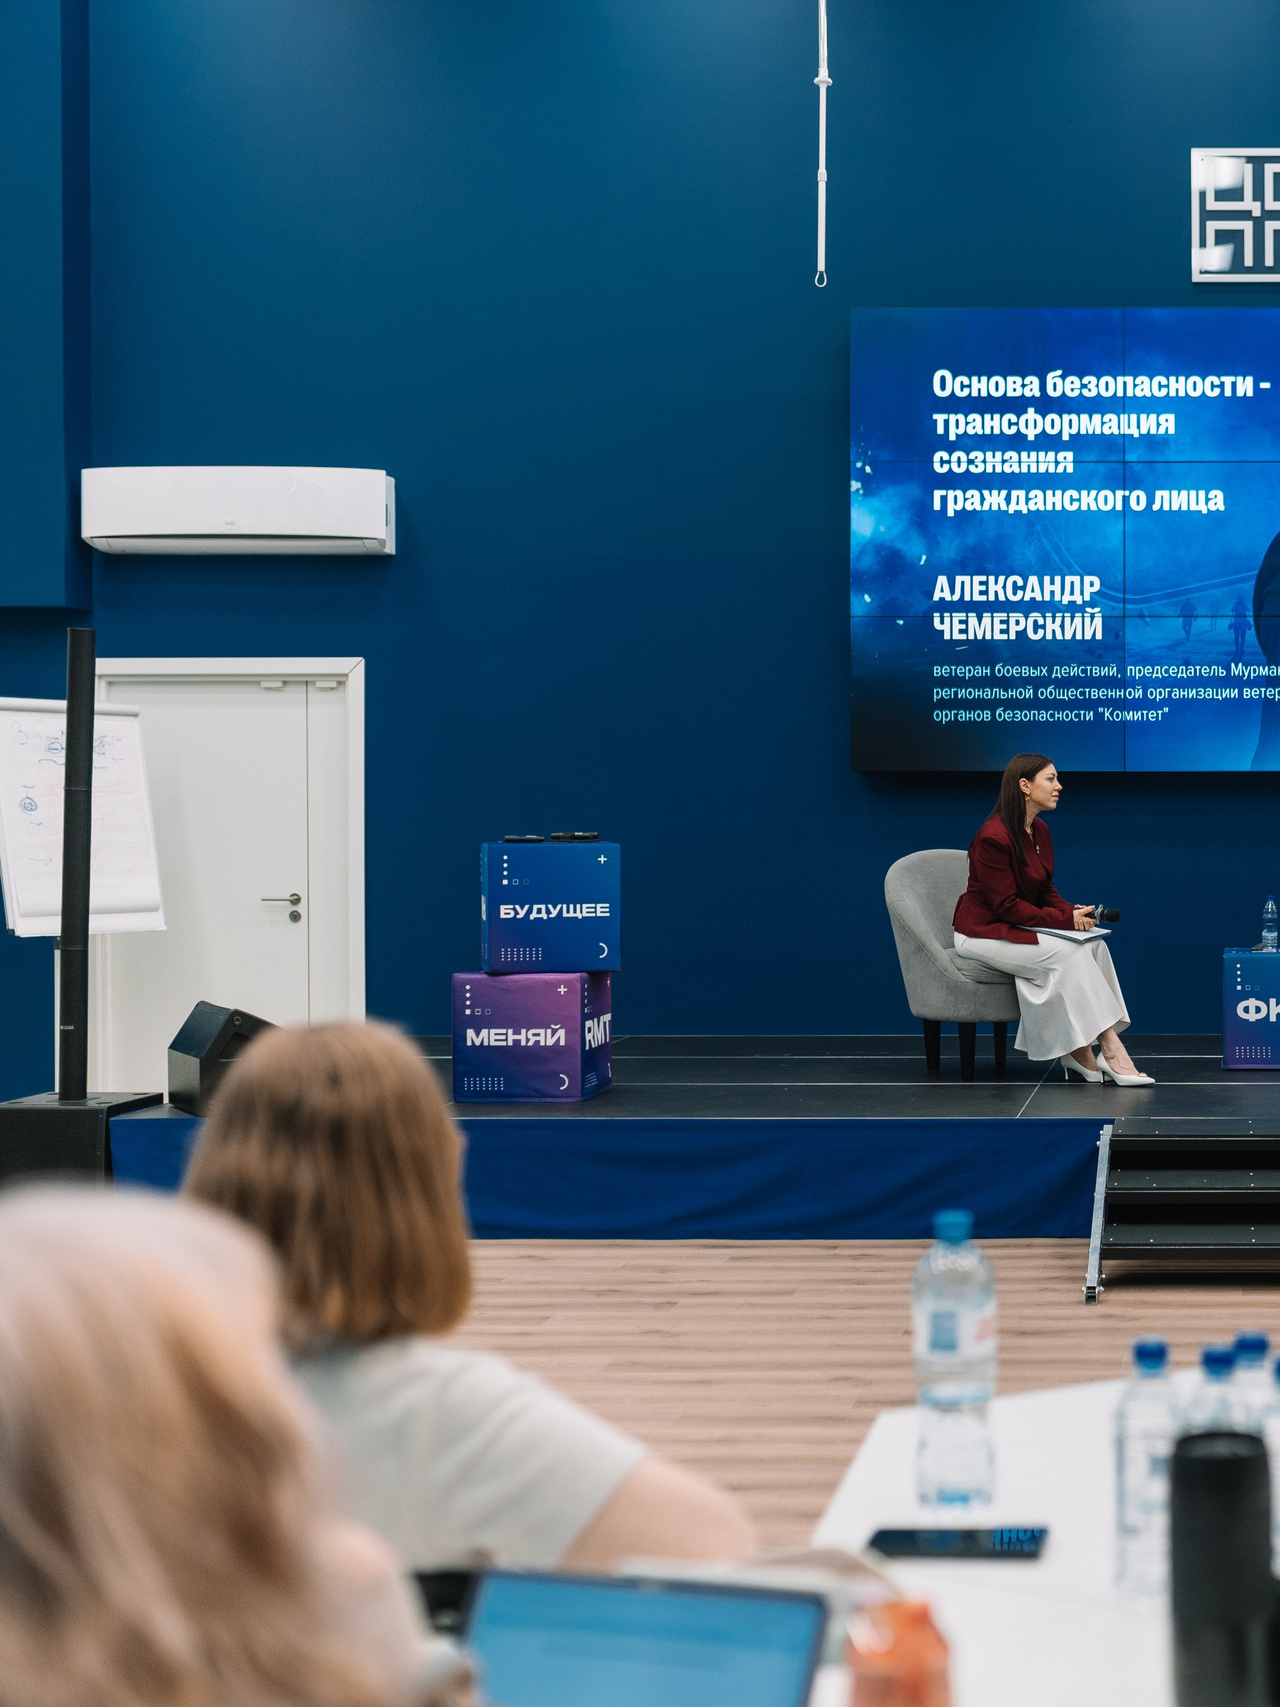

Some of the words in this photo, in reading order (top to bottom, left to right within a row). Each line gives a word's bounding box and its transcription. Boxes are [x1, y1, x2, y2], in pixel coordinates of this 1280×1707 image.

[932, 369, 1041, 398] Основа
[1046, 369, 1254, 398] безопасности
[932, 407, 1176, 441] трансформация
[933, 450, 1074, 474] сознания
[933, 489, 1147, 517] гражданского
[1151, 489, 1225, 514] лица
[932, 575, 1101, 605] АЛЕКСАНДР
[933, 607, 1103, 641] ЧЕМЕРСКИЙ
[933, 664, 991, 680] ветеран
[994, 663, 1048, 677] боевых
[1051, 663, 1121, 680] действий,
[1127, 664, 1227, 680] председатель
[933, 686, 1034, 703] региональной
[1037, 686, 1143, 702] общественной
[1147, 686, 1239, 702] организации
[933, 708, 991, 725] органов
[995, 708, 1094, 722] безопасности
[1098, 707, 1169, 722] "Комитет"
[499, 903, 610, 920] БУДУЩЕЕ
[466, 1024, 566, 1046] МЕНЯЙ
[585, 1013, 611, 1050] RMT
